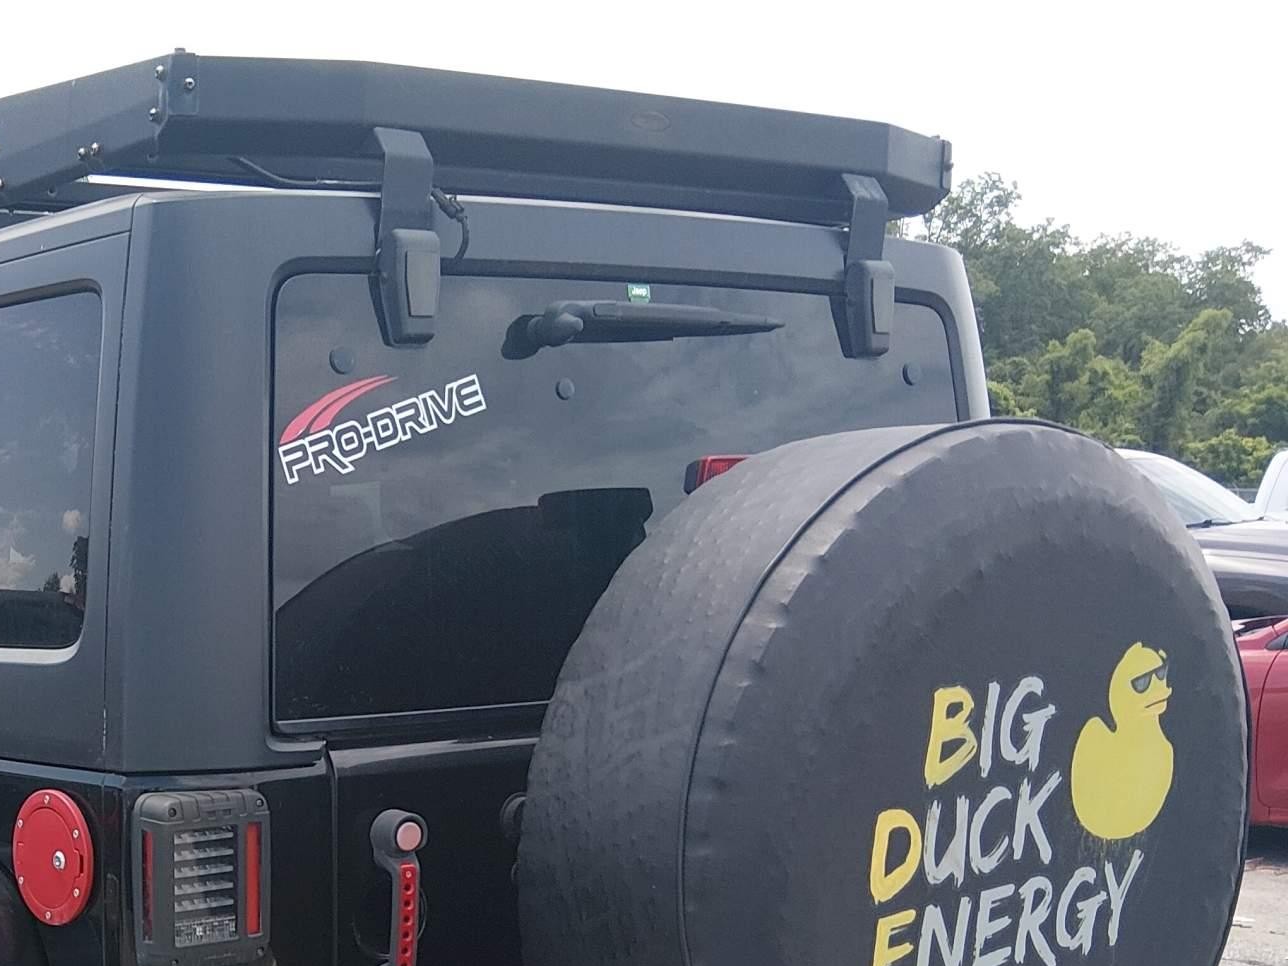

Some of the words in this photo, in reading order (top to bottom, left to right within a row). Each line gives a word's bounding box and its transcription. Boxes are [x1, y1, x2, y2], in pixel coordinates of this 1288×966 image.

[278, 374, 487, 485] PRO-DRIVE
[924, 676, 1056, 789] BIG
[869, 769, 1062, 904] DUCK
